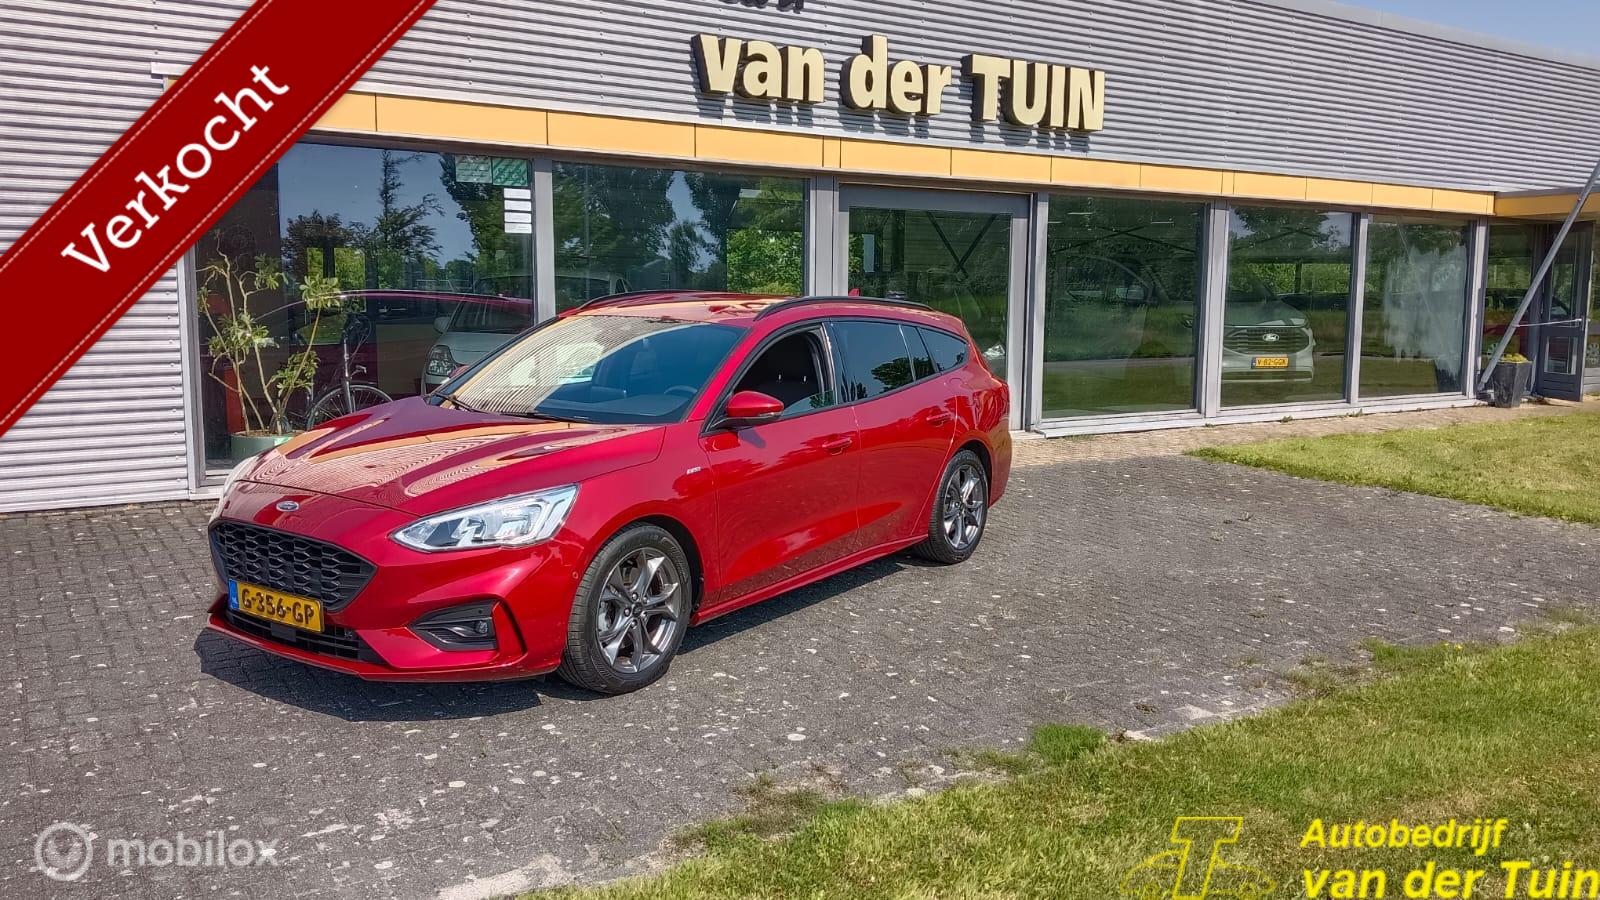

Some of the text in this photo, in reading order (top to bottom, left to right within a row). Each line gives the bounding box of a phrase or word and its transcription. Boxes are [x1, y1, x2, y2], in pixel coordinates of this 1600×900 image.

[692, 34, 1105, 131] van der TUIN
[241, 587, 315, 625] G-356-GP
